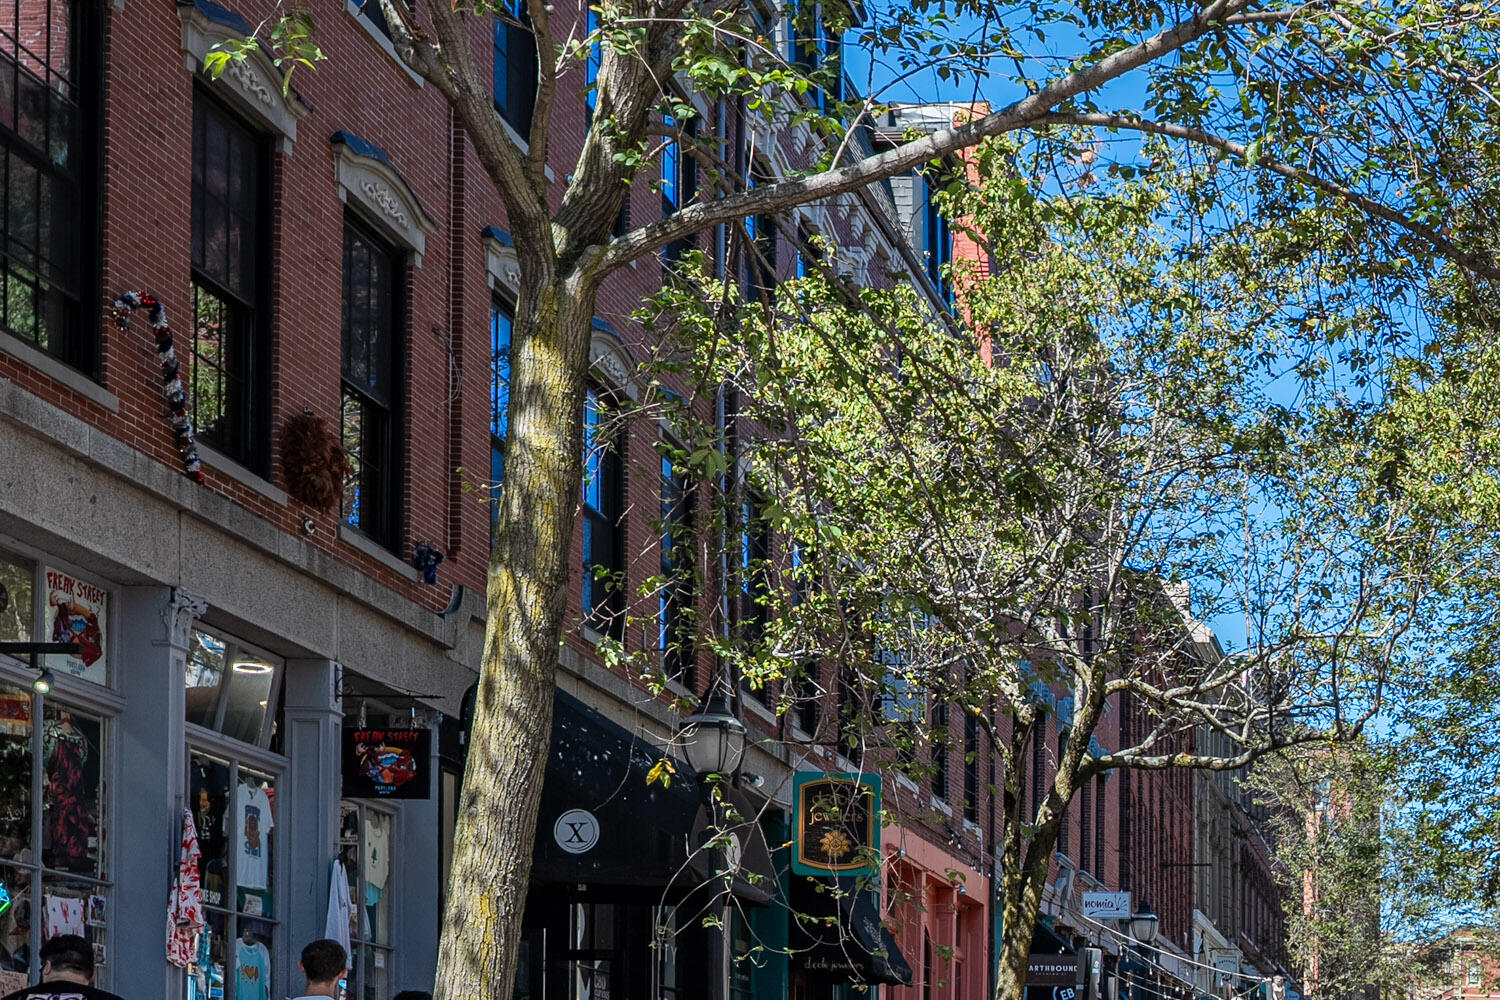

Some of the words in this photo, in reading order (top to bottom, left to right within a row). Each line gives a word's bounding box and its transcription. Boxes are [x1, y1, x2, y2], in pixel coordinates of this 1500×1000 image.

[46, 572, 75, 596] FREAK
[76, 582, 105, 606] STREET
[354, 730, 384, 742] FREAK
[388, 731, 420, 742] STREET
[564, 822, 588, 844] X
[1084, 898, 1114, 908] nomia
[1028, 964, 1078, 972] ARTHBOUND
